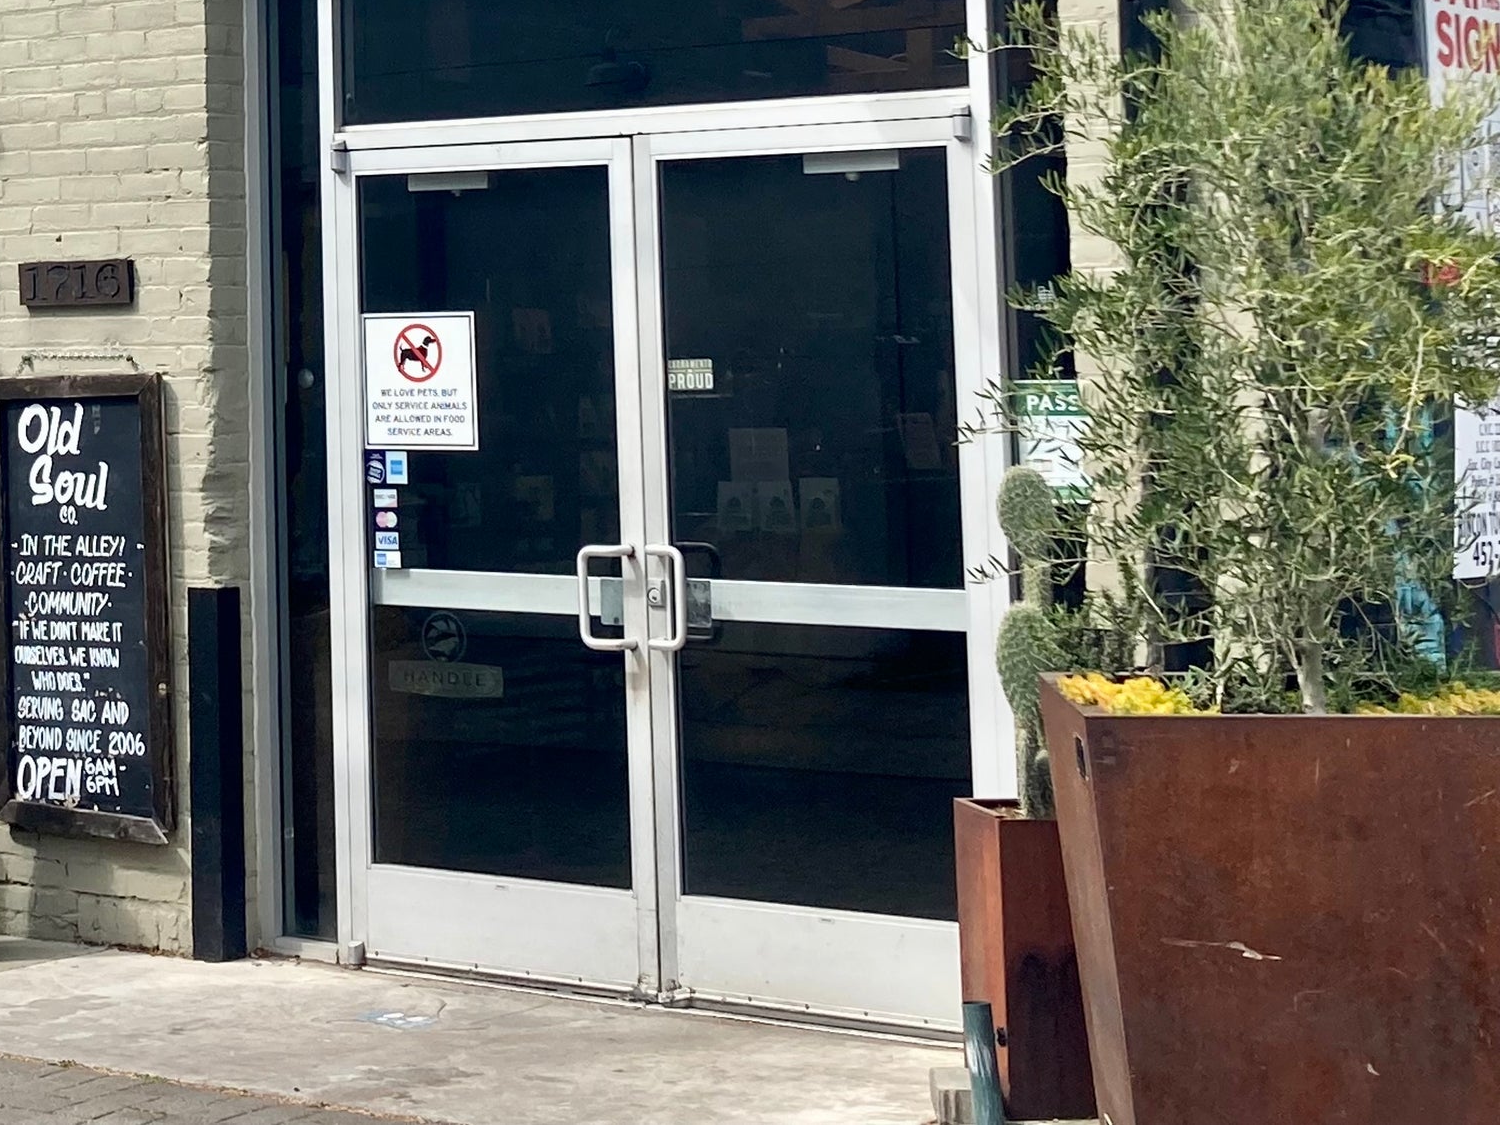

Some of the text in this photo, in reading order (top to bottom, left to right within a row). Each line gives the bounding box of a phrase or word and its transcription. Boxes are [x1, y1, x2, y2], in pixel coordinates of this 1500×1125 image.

[668, 372, 714, 389] PROUD
[380, 388, 392, 396] WE
[393, 388, 415, 397] LOVE
[441, 388, 457, 397] BUT
[1026, 394, 1081, 412] PASS
[372, 401, 467, 410] ONLY SERVICE ANIMALS
[18, 402, 84, 455] Old
[375, 414, 465, 423] ARE ALLOWED IN FOOD
[387, 427, 421, 436] SERVICE
[29, 454, 108, 510] Soul
[20, 533, 125, 557] IN THE ALLEY!
[378, 536, 398, 545] VISA
[15, 561, 126, 587] CRAFT COFFEE
[28, 591, 109, 617] COMMUNITY
[31, 619, 48, 640] WE
[81, 621, 111, 642] MAKE
[112, 622, 122, 643] IT
[69, 646, 87, 667] WE
[89, 647, 120, 668] KNOW
[31, 670, 56, 691] WHO
[17, 695, 130, 726] SERVING SAC AND
[17, 725, 146, 756] BEYOND SINCE 2006
[17, 754, 82, 801] OPEN
[85, 776, 120, 797] 6PM
